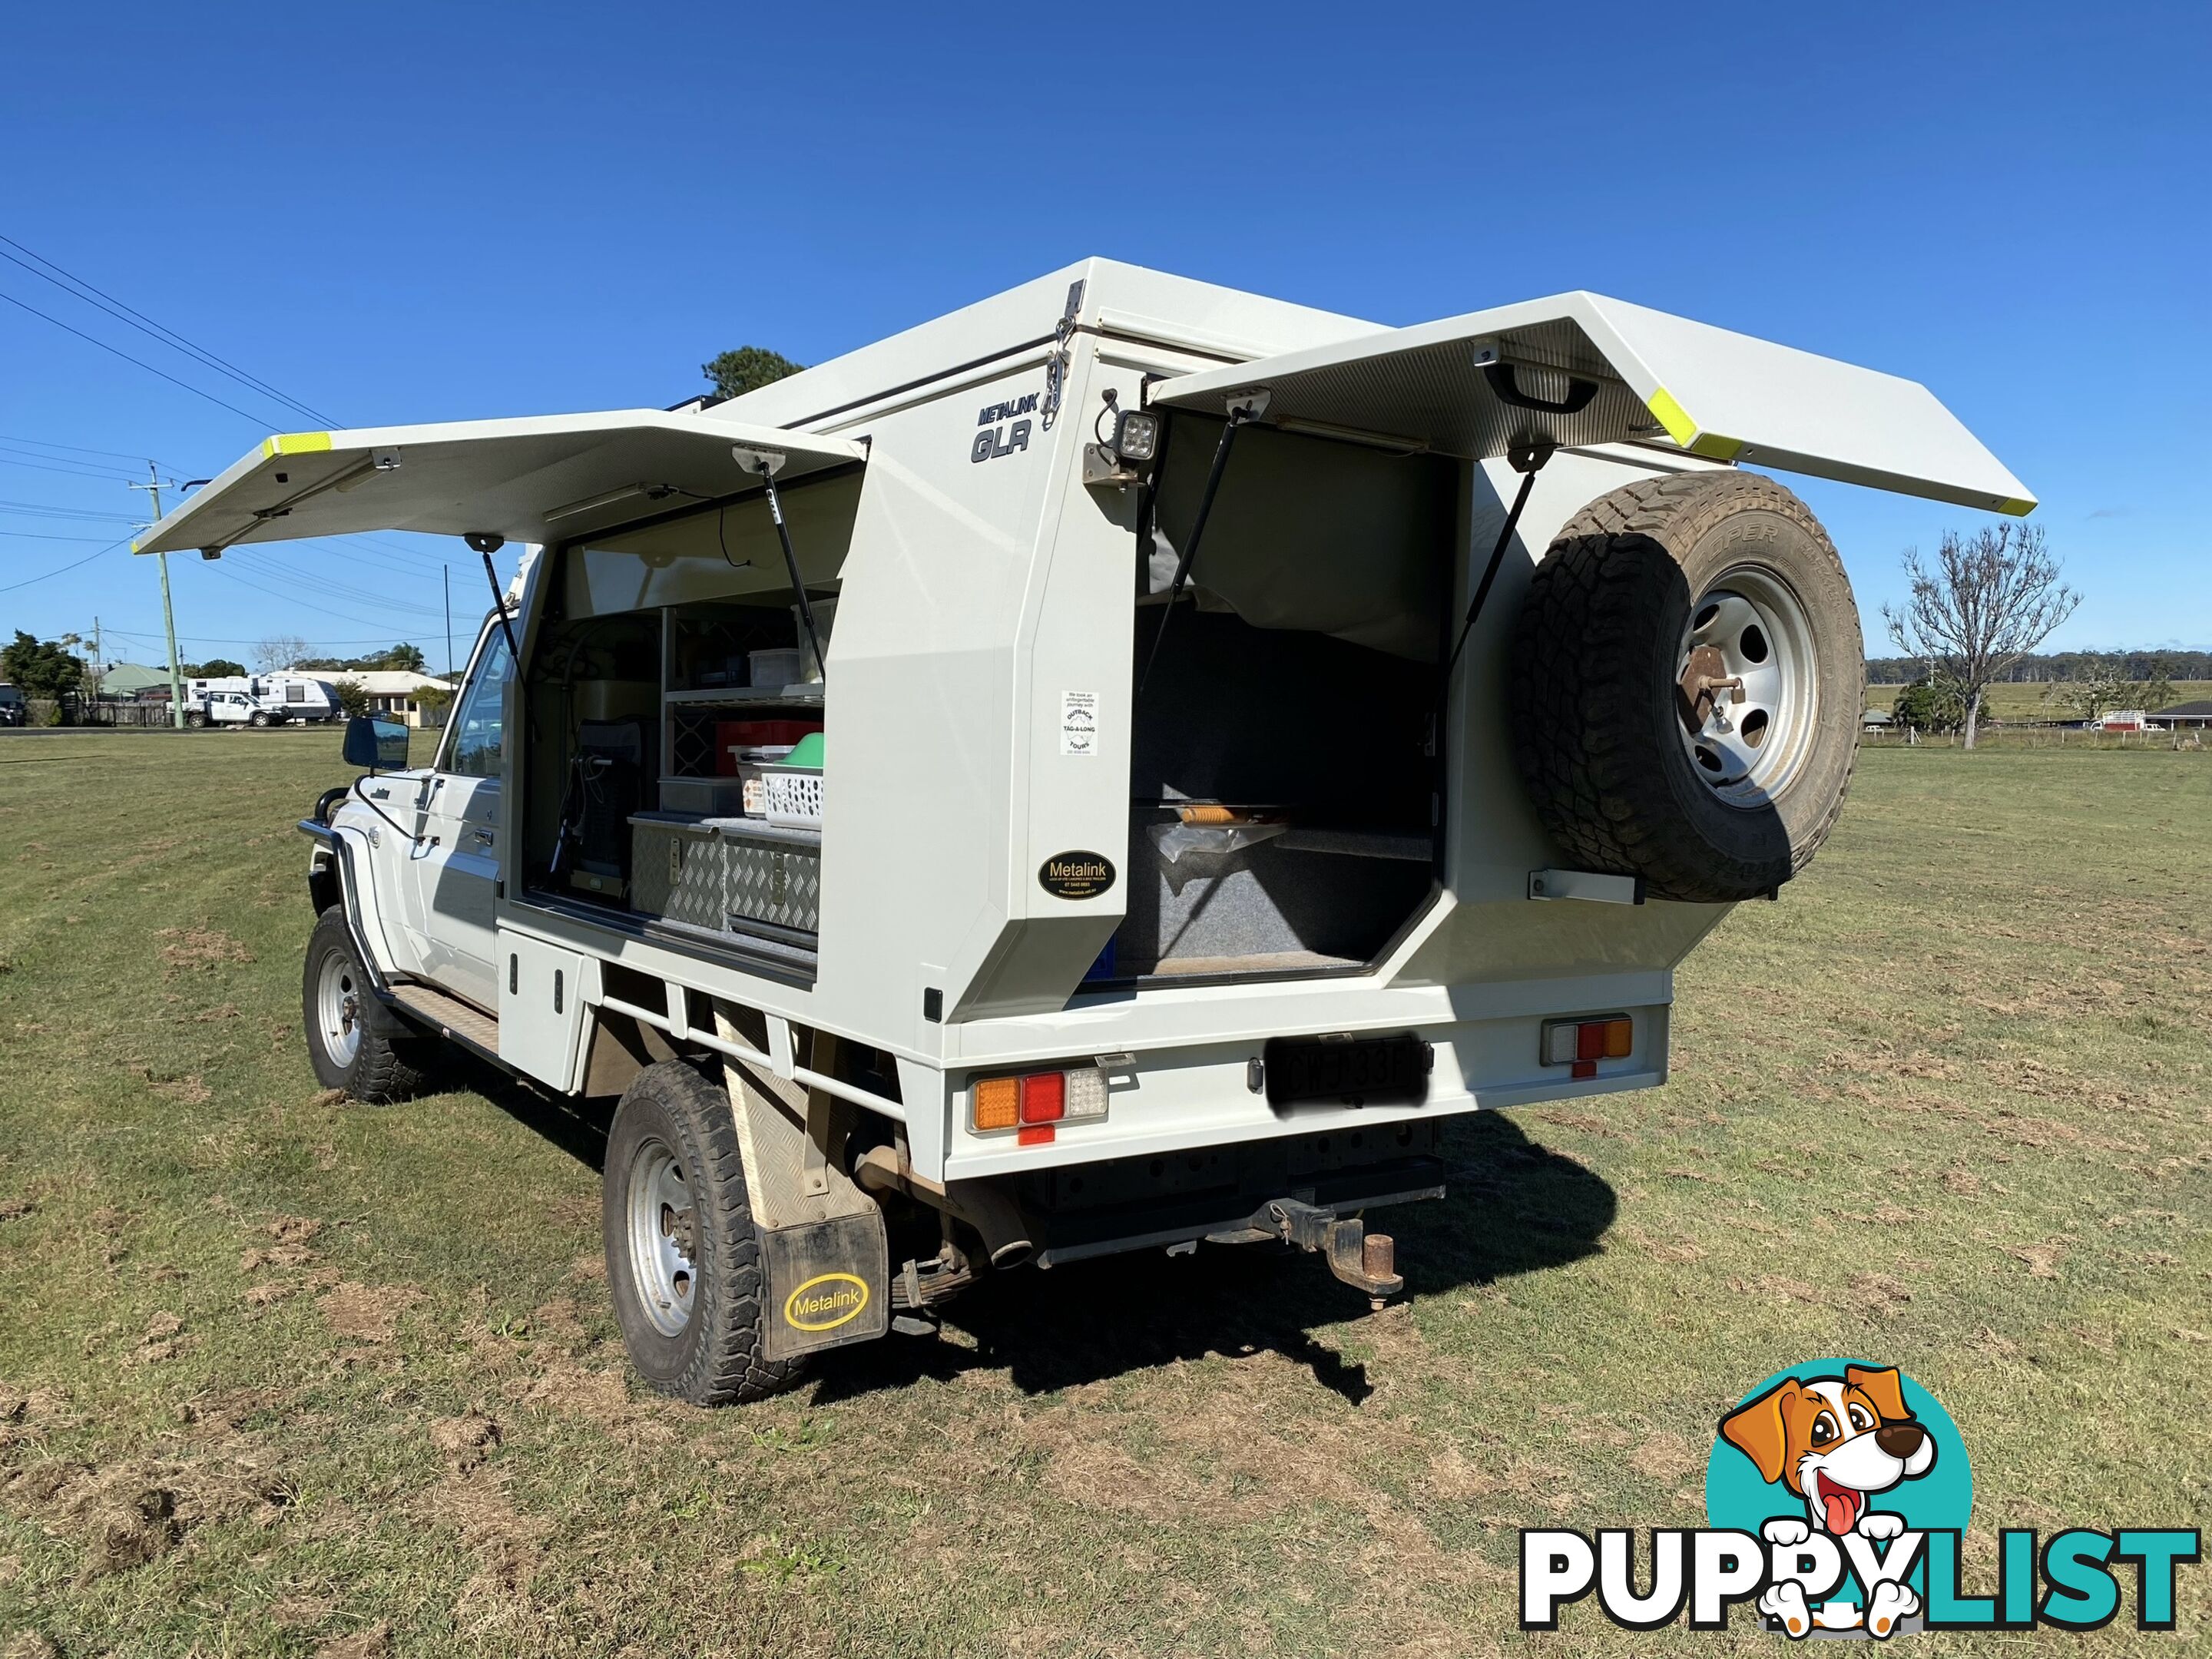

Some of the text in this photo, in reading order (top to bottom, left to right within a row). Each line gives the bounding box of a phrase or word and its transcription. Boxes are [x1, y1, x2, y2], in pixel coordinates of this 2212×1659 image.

[977, 392, 1040, 426] METALINK
[971, 419, 1031, 463] GLR
[1067, 709, 1093, 720] OUTBACK
[1070, 740, 1090, 750] TOURS
[1050, 862, 1106, 877] Metalink
[795, 1289, 859, 1316] Metalink
